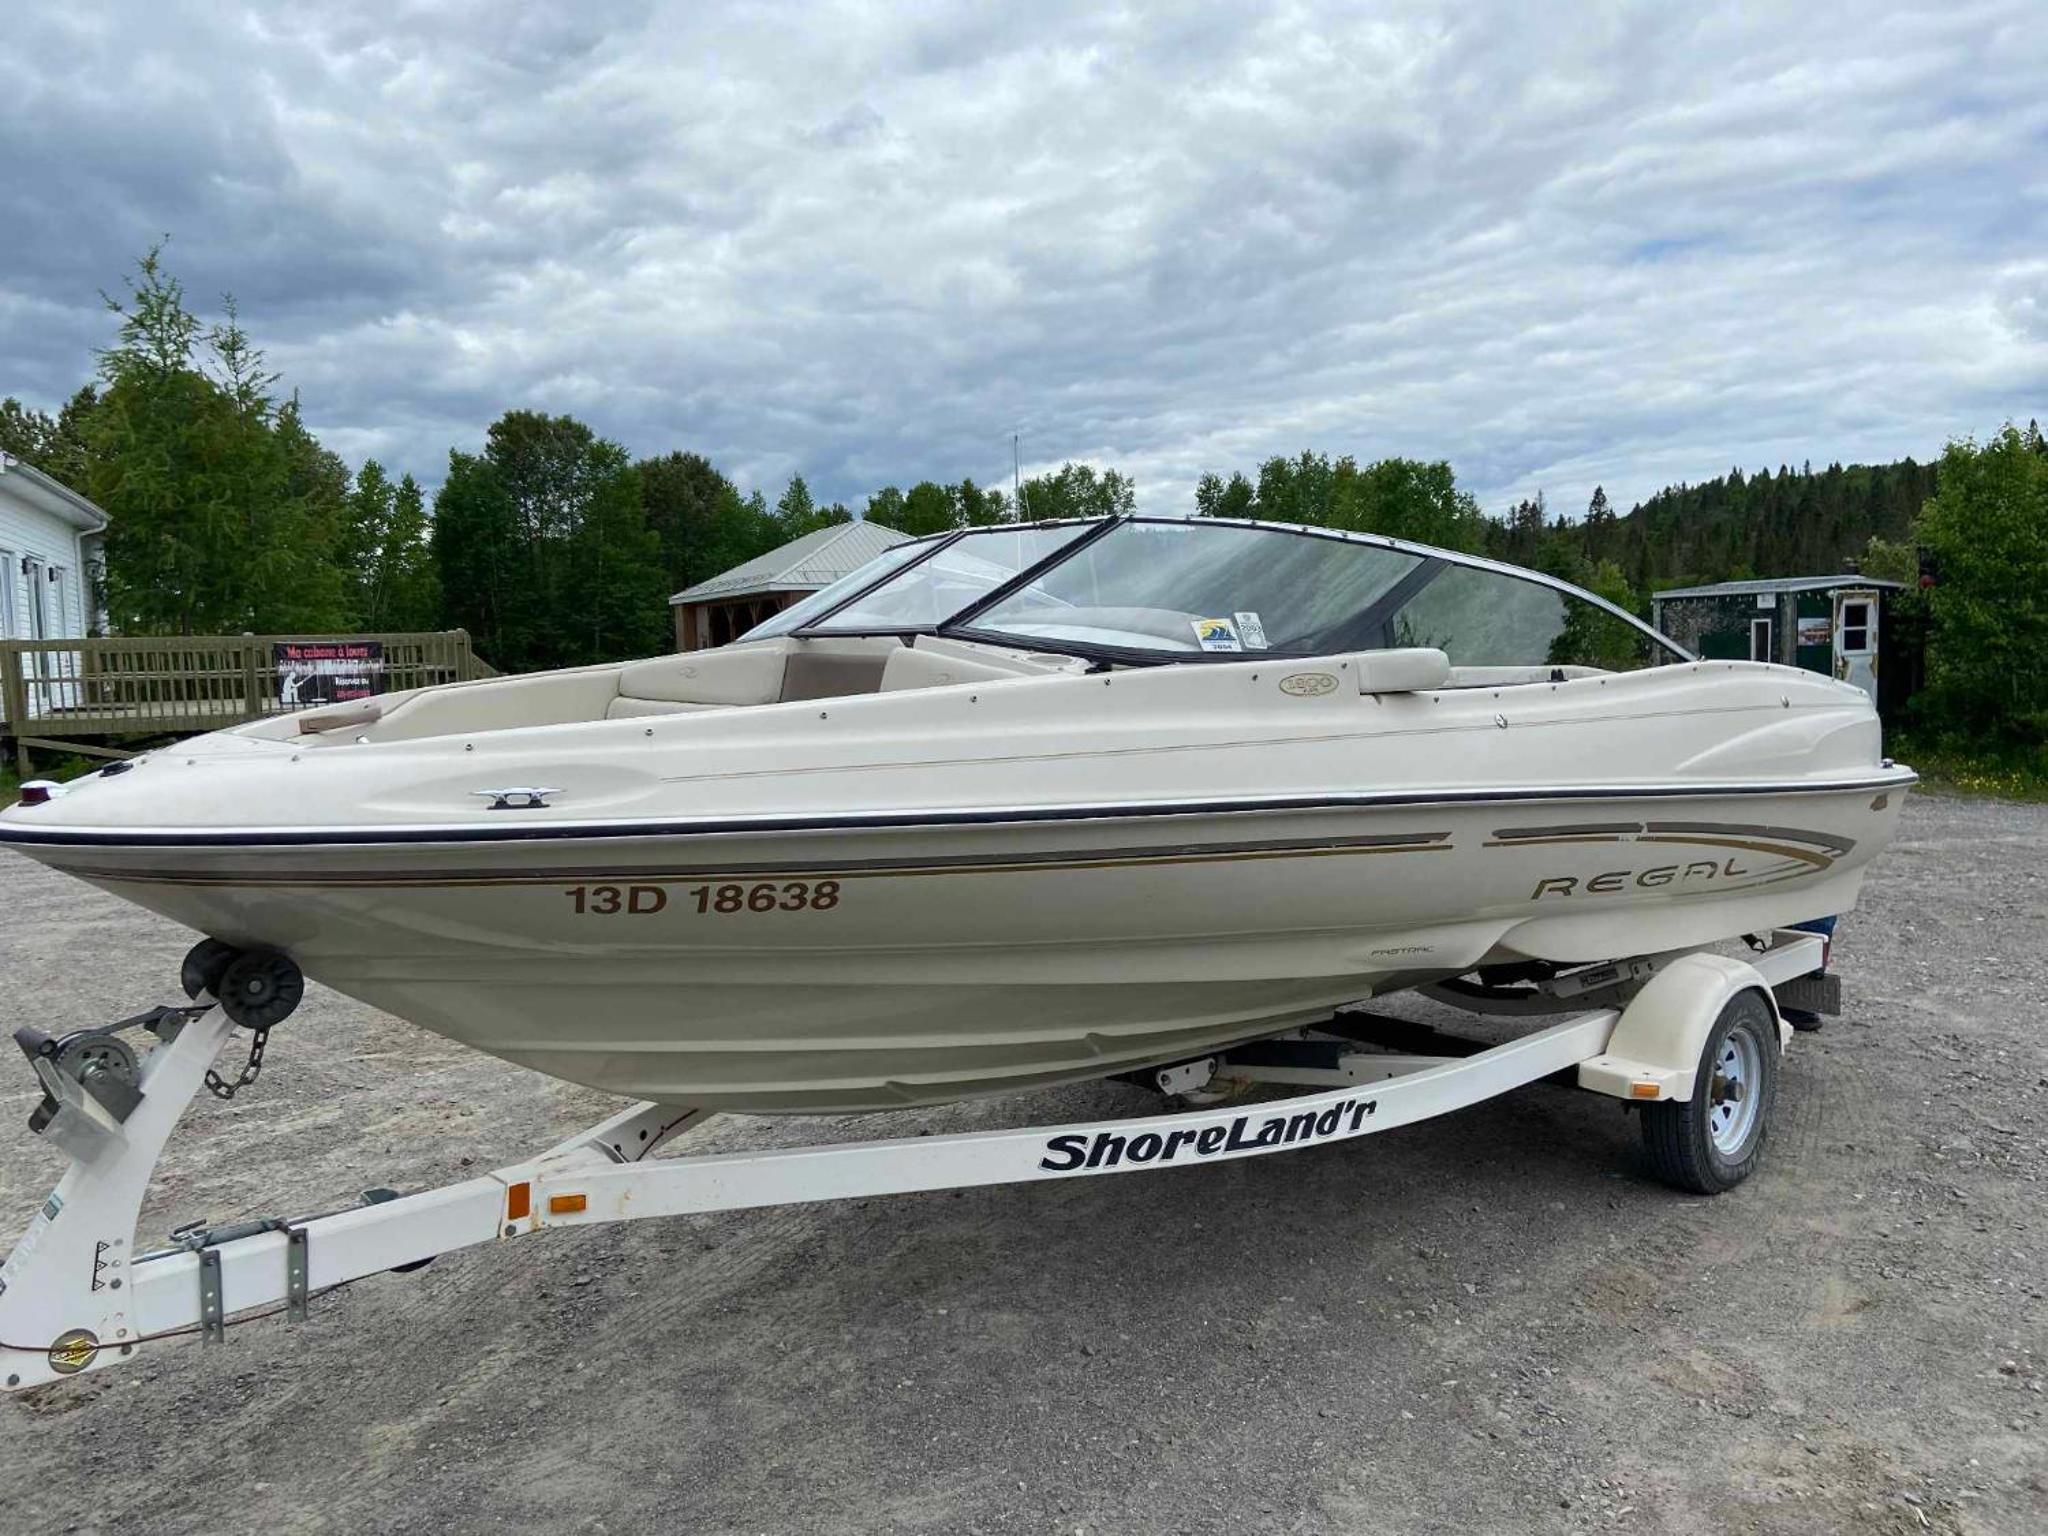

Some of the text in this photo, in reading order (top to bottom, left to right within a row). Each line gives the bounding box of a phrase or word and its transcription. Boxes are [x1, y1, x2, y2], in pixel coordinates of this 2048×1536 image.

[287, 645, 301, 658] Ma
[564, 881, 840, 914] 13D 18638
[1529, 857, 1748, 901] REGAL
[1039, 1099, 1377, 1171] ShoreLand'r
